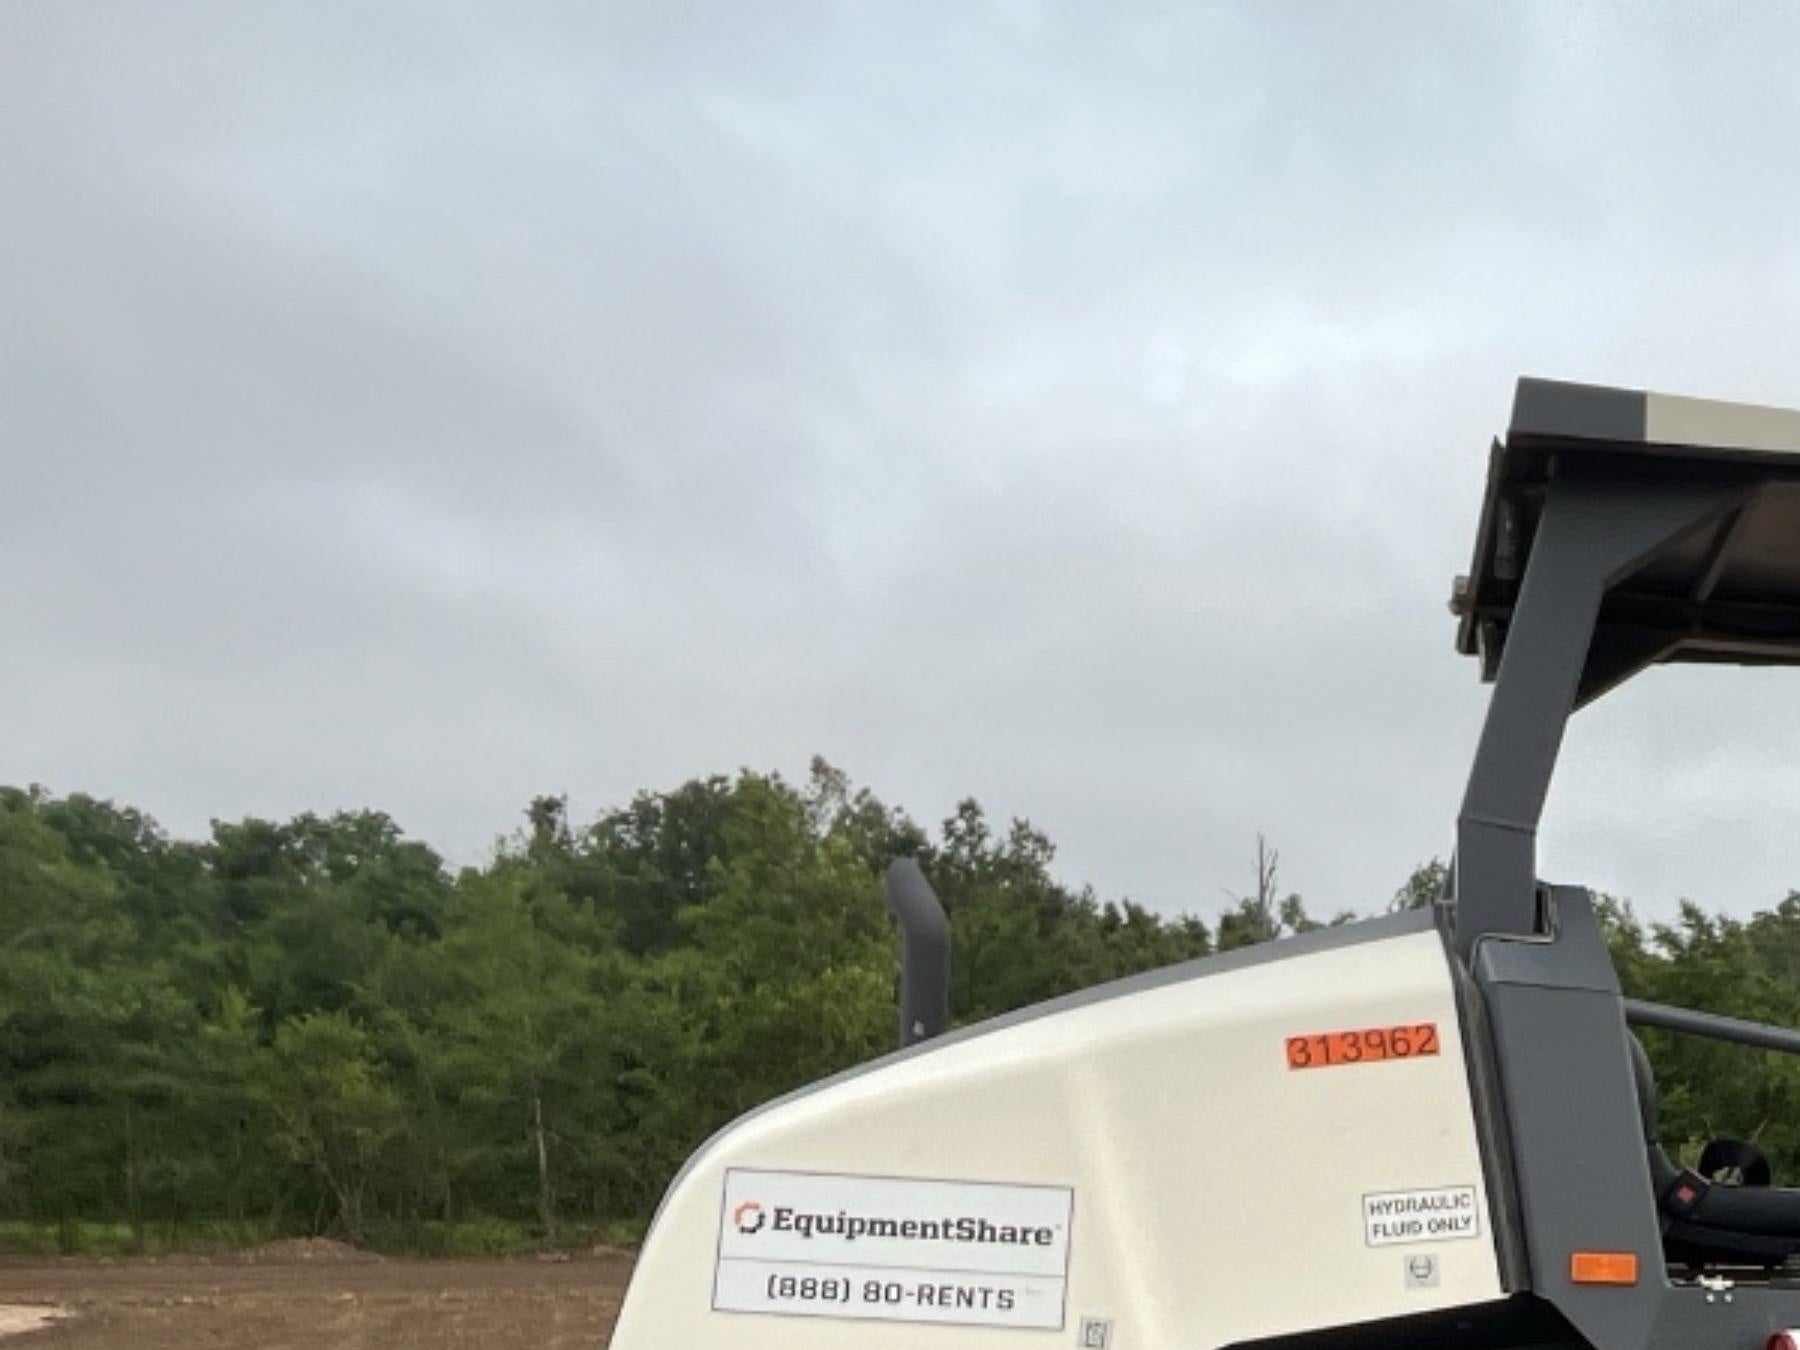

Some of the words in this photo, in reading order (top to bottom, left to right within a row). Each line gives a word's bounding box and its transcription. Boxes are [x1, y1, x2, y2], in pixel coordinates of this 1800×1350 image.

[1286, 1024, 1438, 1069] 313962
[1368, 1192, 1471, 1216] HYDRAULIC
[771, 1205, 1054, 1248] EquipmentShare
[1372, 1220, 1423, 1239] FLUID
[1427, 1214, 1472, 1234] ONLY
[767, 1273, 851, 1303] (888)
[862, 1278, 1017, 1311] 80-RENTS
